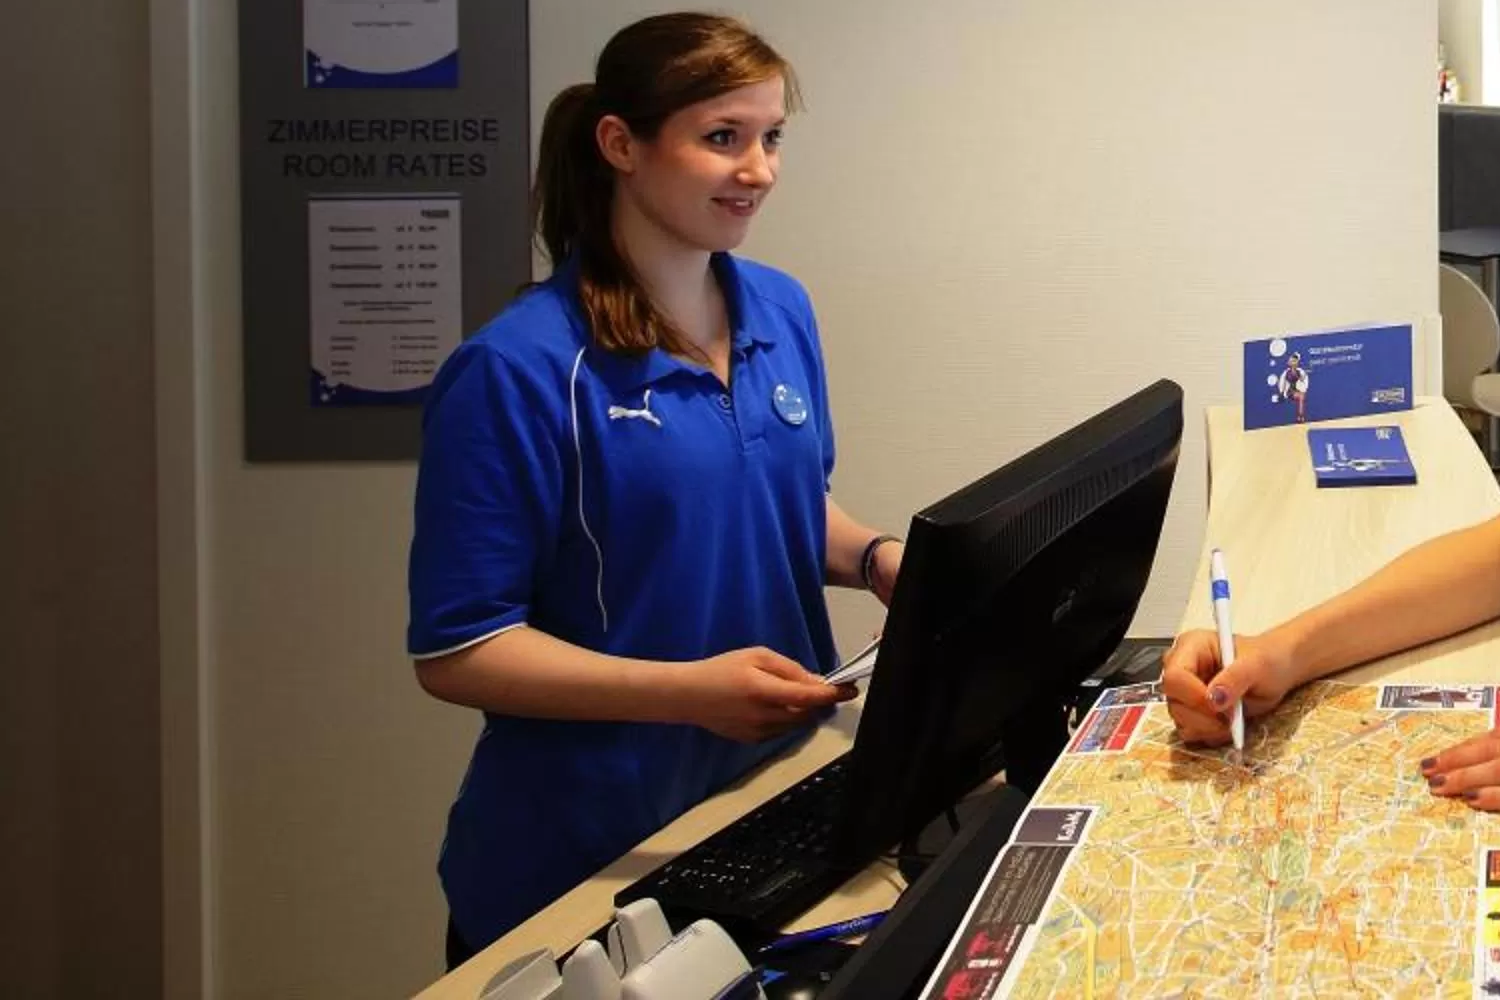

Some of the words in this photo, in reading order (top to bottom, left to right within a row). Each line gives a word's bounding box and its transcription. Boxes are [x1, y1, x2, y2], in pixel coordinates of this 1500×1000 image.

[267, 119, 500, 143] ZIMMERPREISE
[282, 153, 376, 178] ROOM
[386, 153, 488, 178] RATES
